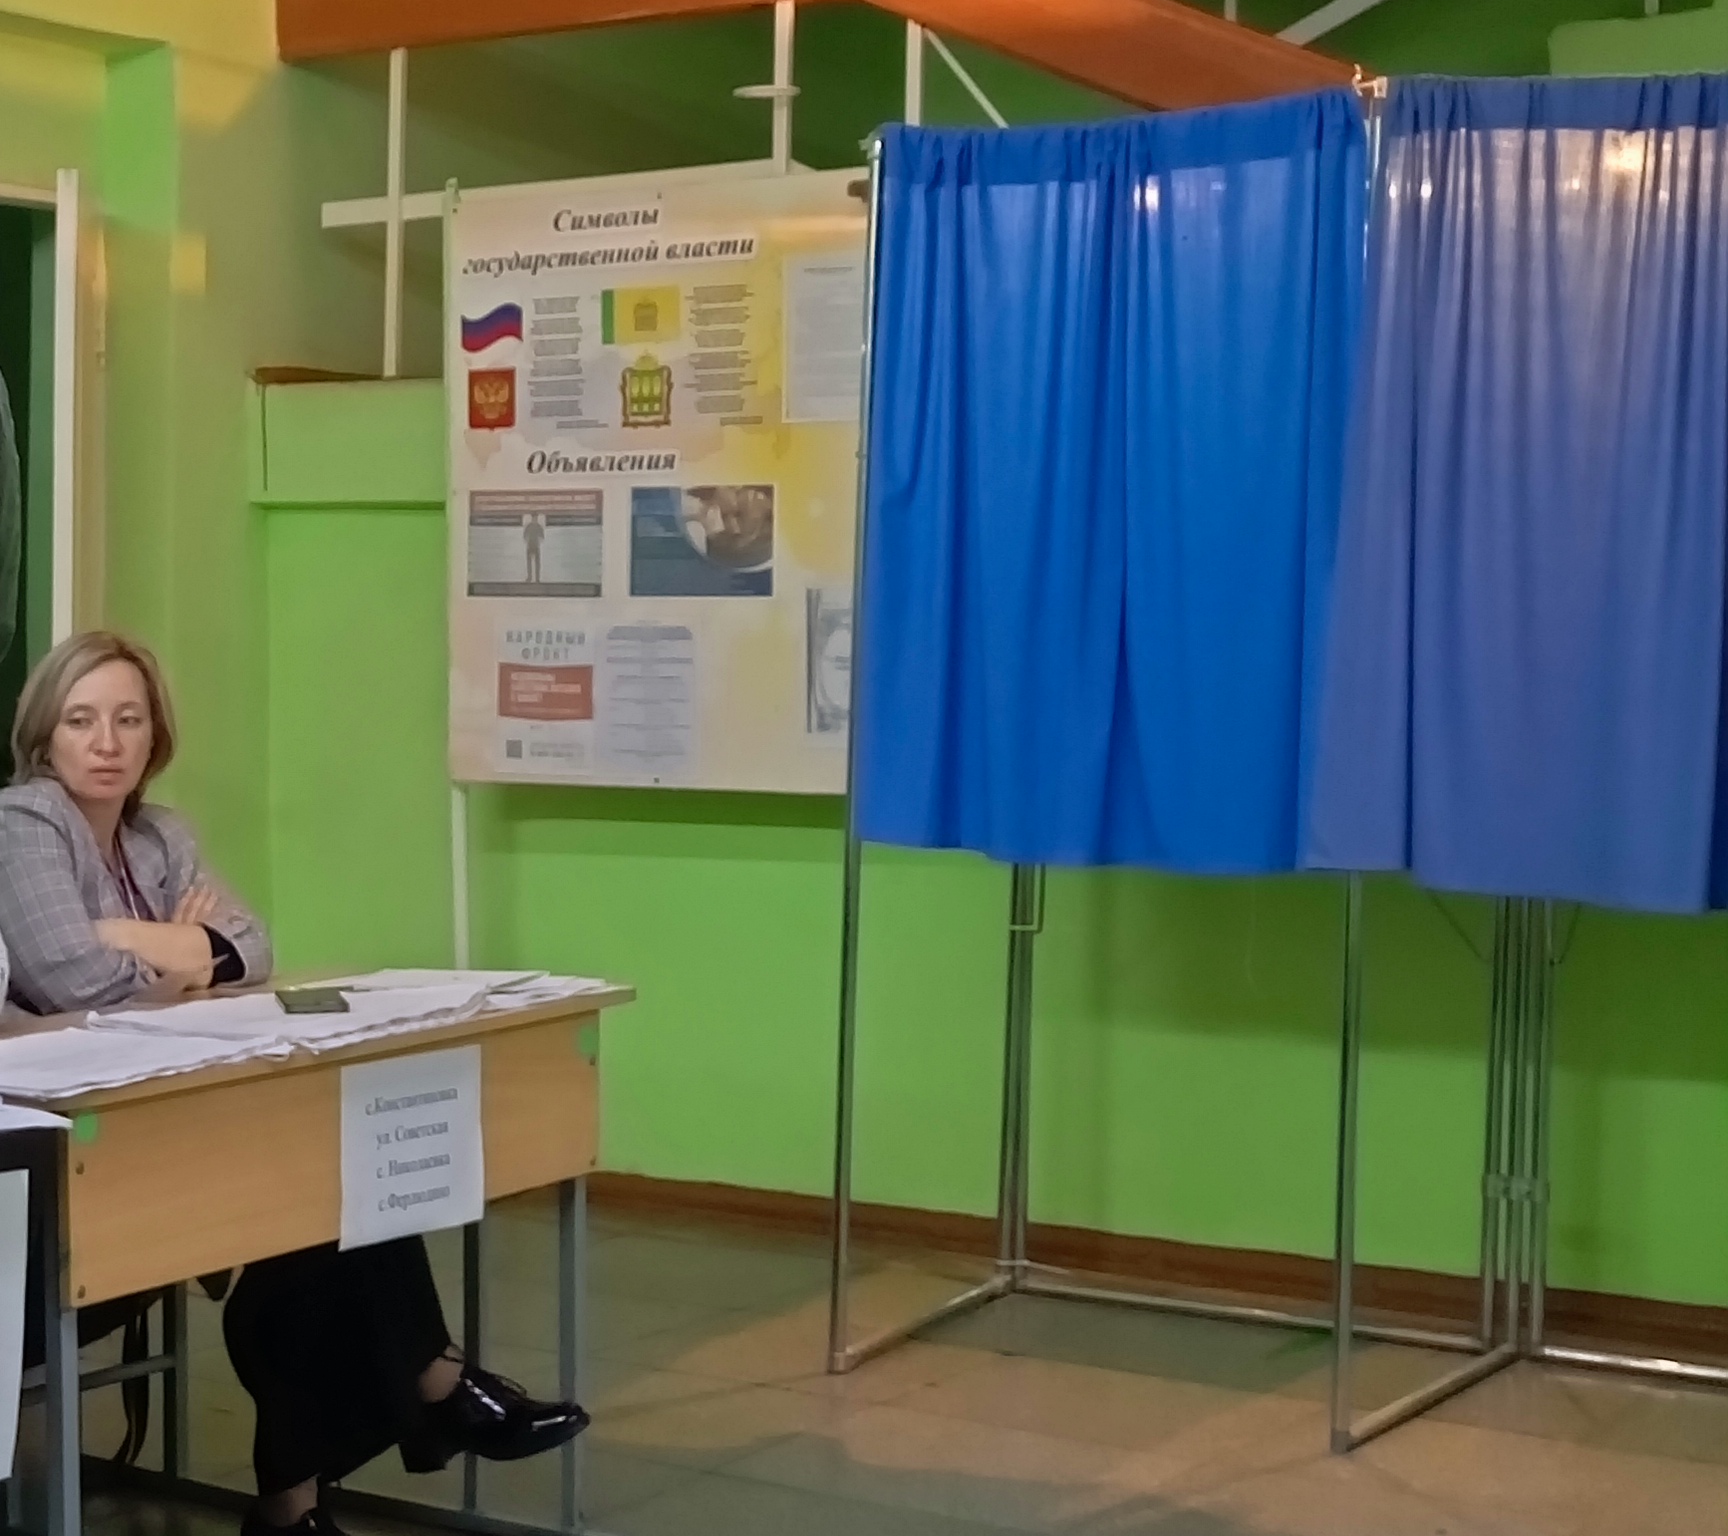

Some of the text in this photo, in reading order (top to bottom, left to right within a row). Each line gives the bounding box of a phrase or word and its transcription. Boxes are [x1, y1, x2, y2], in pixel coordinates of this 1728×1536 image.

[552, 208, 660, 232] Символы
[461, 237, 755, 279] государственной власти
[526, 449, 677, 475] Объявления
